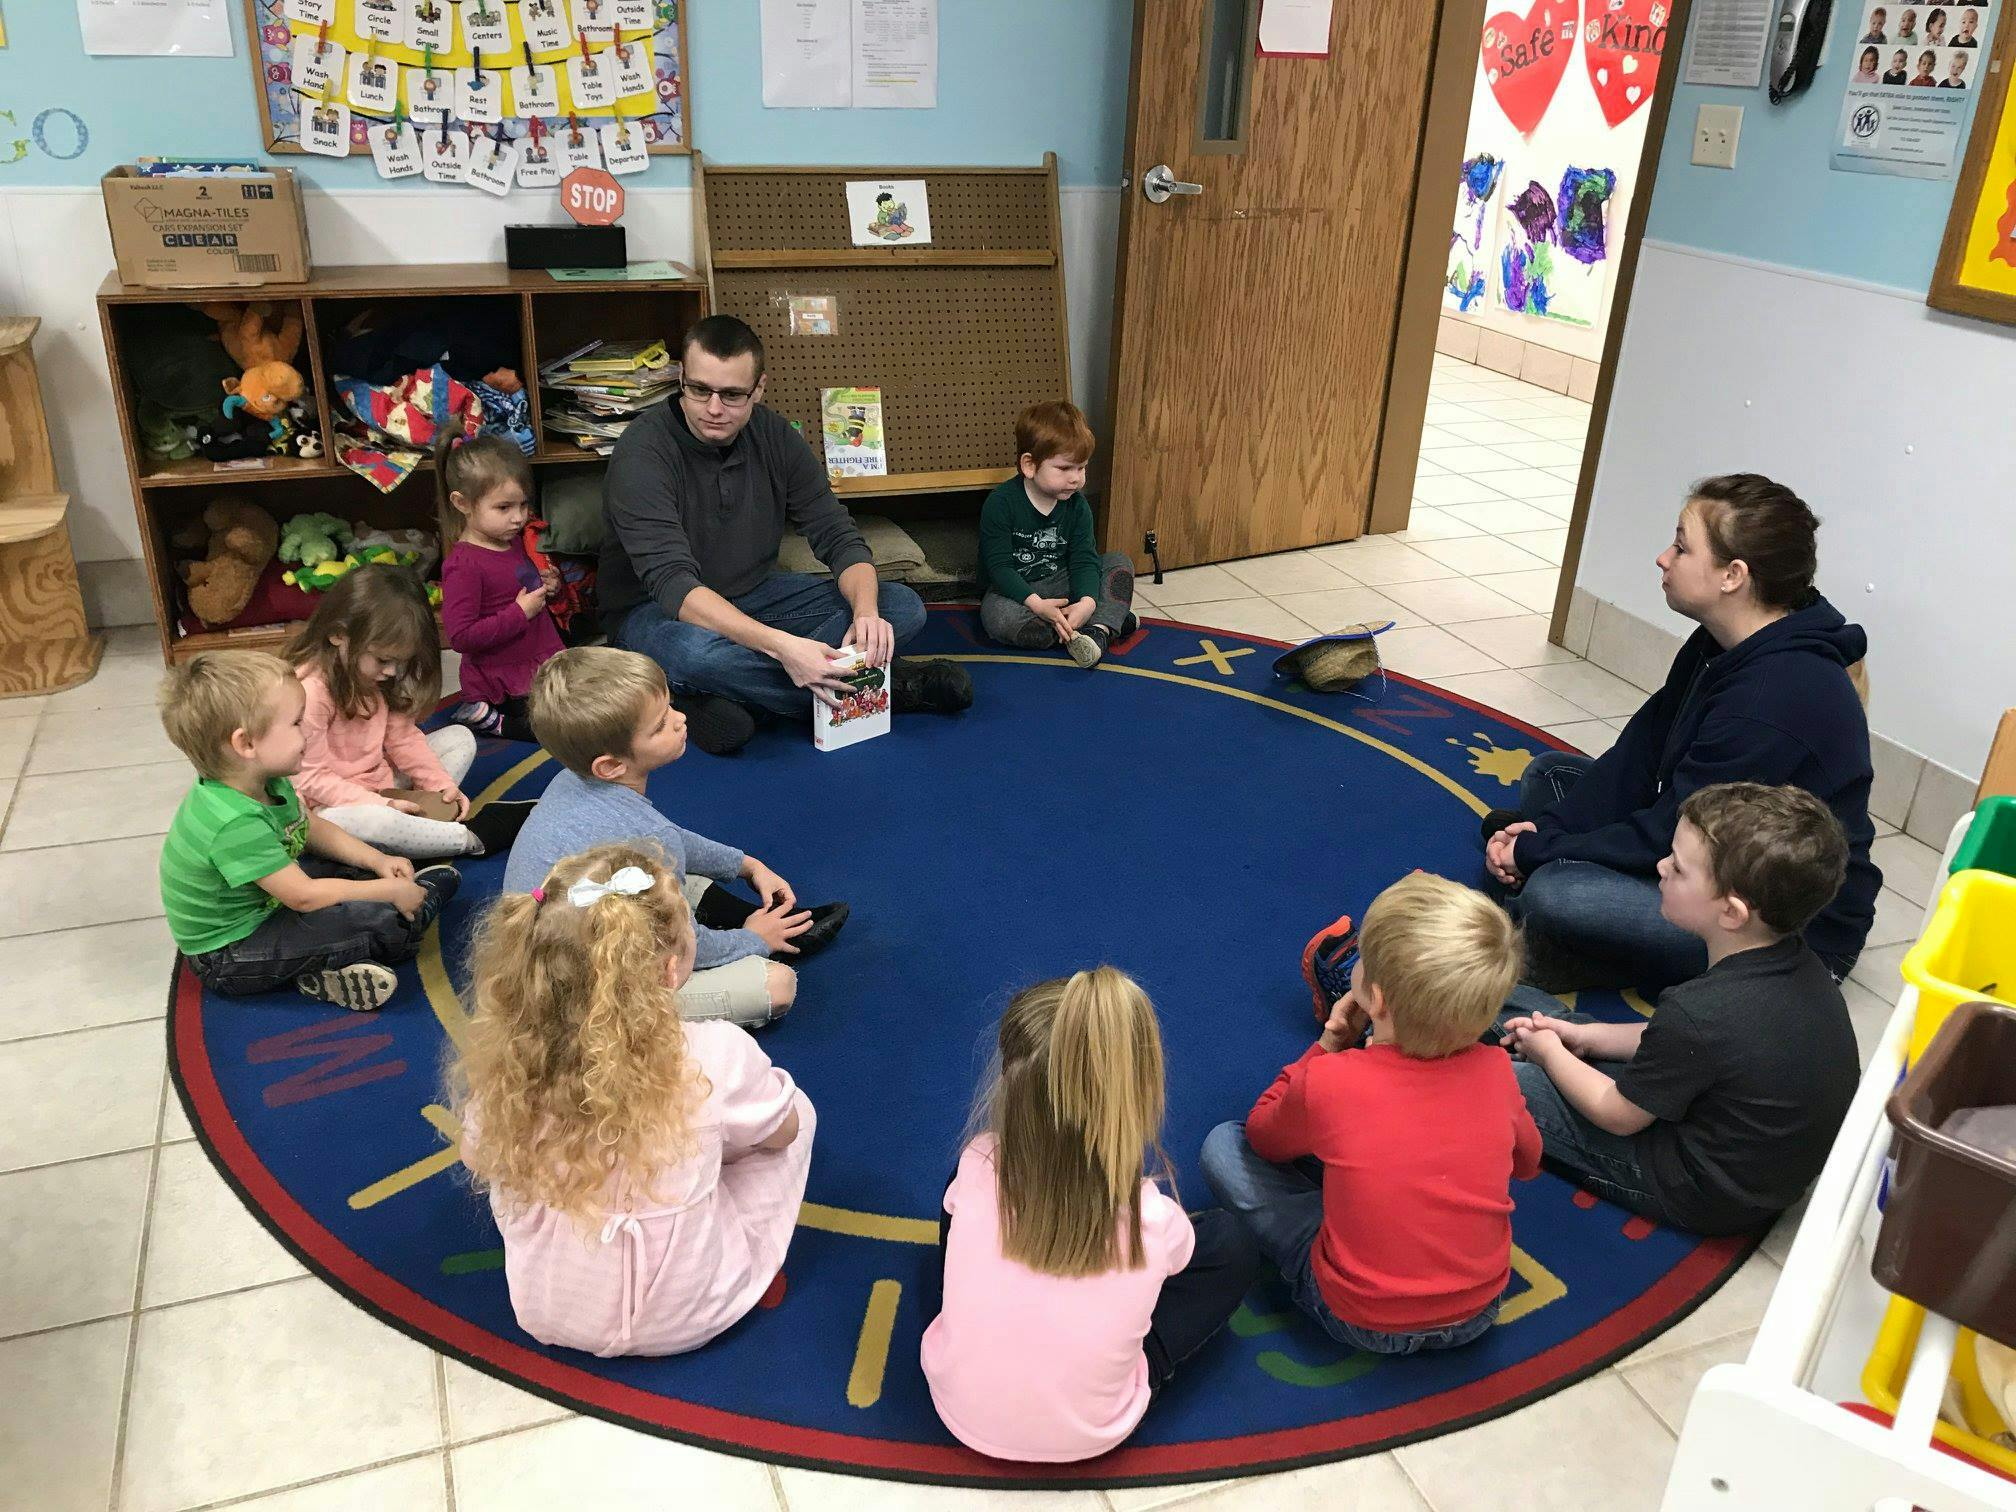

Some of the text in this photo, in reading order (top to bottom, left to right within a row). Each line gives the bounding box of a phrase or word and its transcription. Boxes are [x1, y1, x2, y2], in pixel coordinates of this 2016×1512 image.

[298, 0, 321, 11] Story
[616, 5, 645, 14] Outside
[299, 9, 319, 20] Time
[367, 14, 391, 25] Circle
[623, 17, 641, 25] Time
[370, 26, 389, 37] Time
[417, 26, 439, 37] Small
[537, 29, 558, 37] Music
[577, 24, 613, 33] Bathroom
[472, 31, 502, 40] Centers
[541, 39, 559, 47] Time
[1500, 27, 1555, 77] Safe
[306, 66, 329, 79] Wash
[620, 72, 641, 83] Wash
[303, 78, 327, 90] Hand
[582, 81, 603, 90] Table
[622, 83, 645, 93] Hands
[360, 90, 384, 102] Lunch
[469, 95, 487, 104] Rest
[585, 92, 603, 102] Toys
[519, 100, 555, 109] Bathroom
[469, 106, 488, 116] Time
[312, 136, 338, 148] Snack
[386, 153, 410, 163] Wash
[568, 153, 588, 161] Table
[609, 153, 645, 165] Departure
[389, 164, 413, 174] Hands
[431, 160, 462, 170] Outside
[437, 172, 456, 180] Time
[521, 167, 556, 176] Free Play
[471, 168, 506, 187] Bathroom
[199, 187, 208, 196] 2
[570, 183, 618, 213] STOP
[163, 208, 249, 218] MAGNA-TILES
[152, 223, 244, 232] CARS EXPANSION SET
[163, 234, 236, 247] CLEAR
